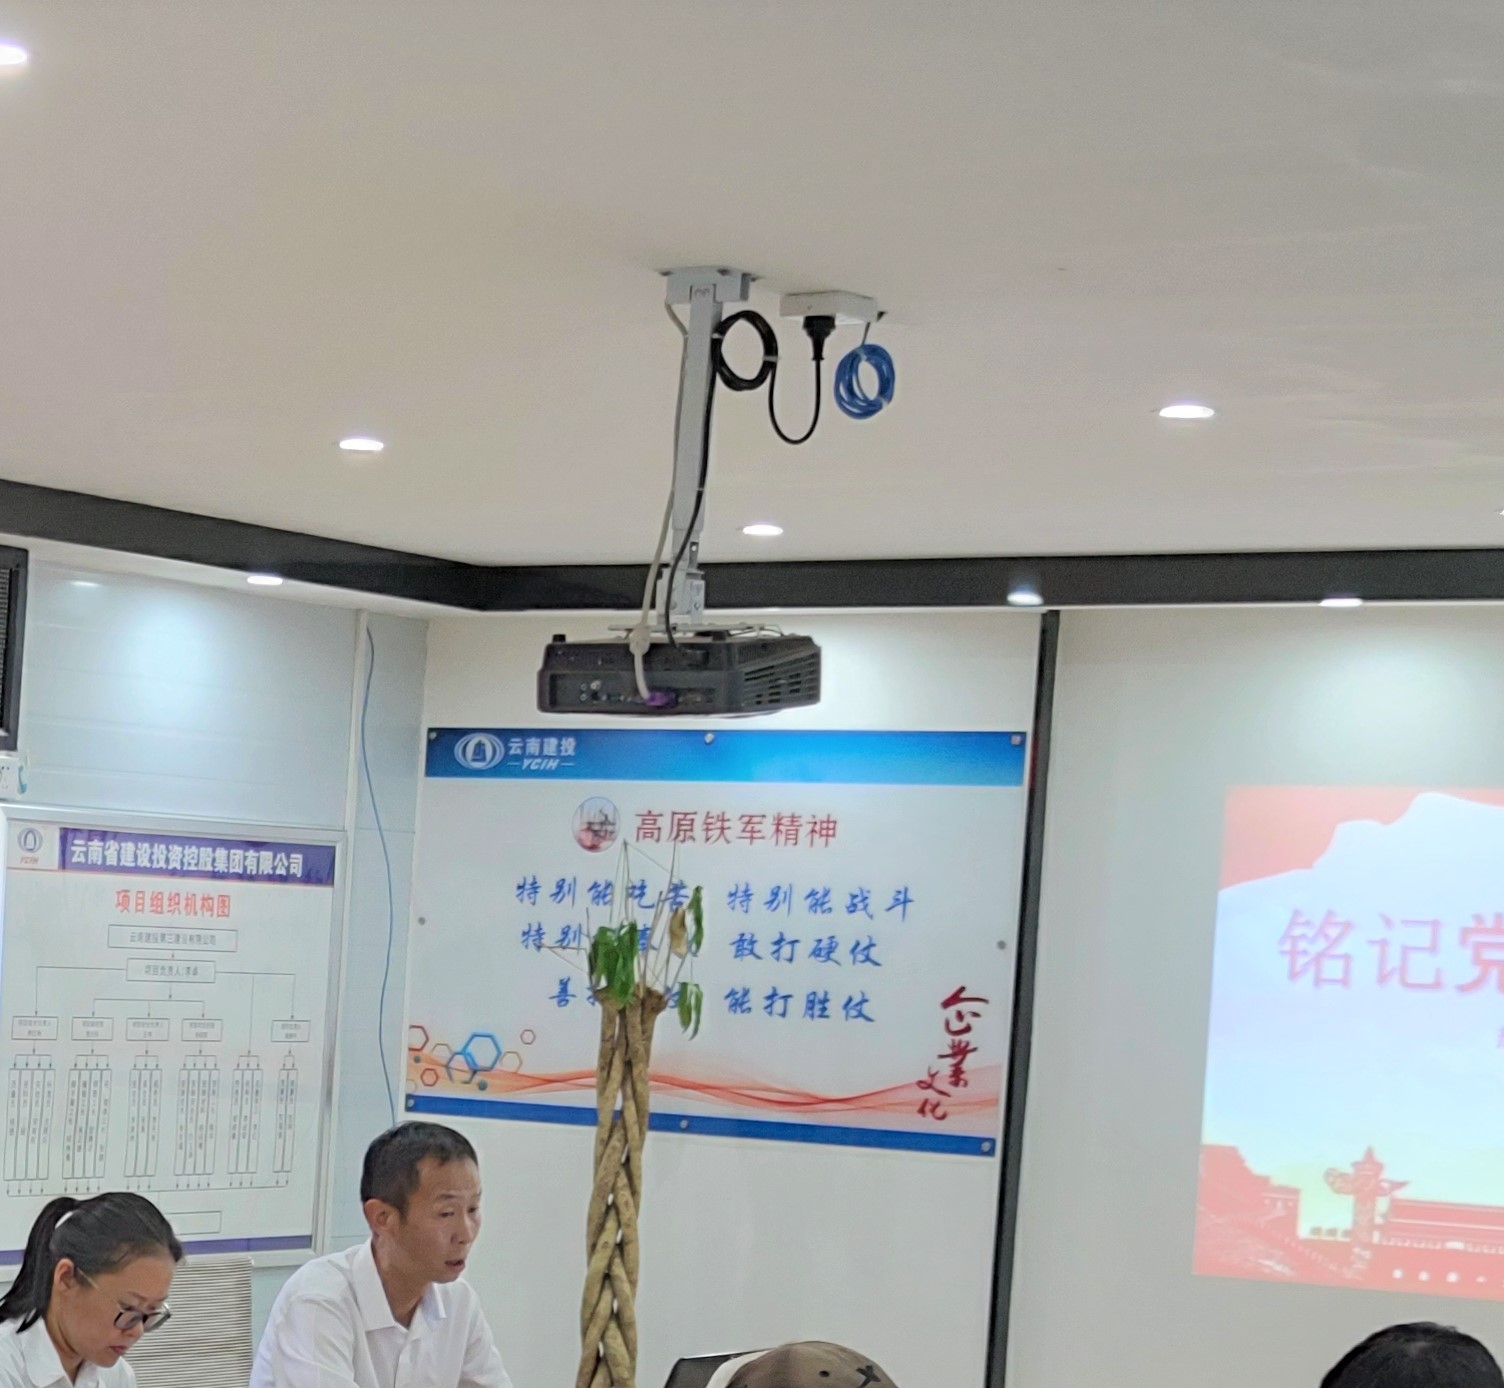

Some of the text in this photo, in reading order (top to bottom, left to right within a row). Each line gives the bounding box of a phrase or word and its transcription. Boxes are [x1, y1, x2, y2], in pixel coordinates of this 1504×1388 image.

[508, 737, 577, 757] 云南建投
[521, 758, 560, 771] YCIH
[634, 809, 839, 849] 高原铁军精神
[70, 838, 304, 879] 云南省建设投资控股集团有限公司
[115, 889, 232, 918] 项目组织机构图
[726, 884, 915, 922] 特别能战斗
[730, 932, 884, 969] 敢打硬仗
[724, 986, 876, 1023] 能打胜仗
